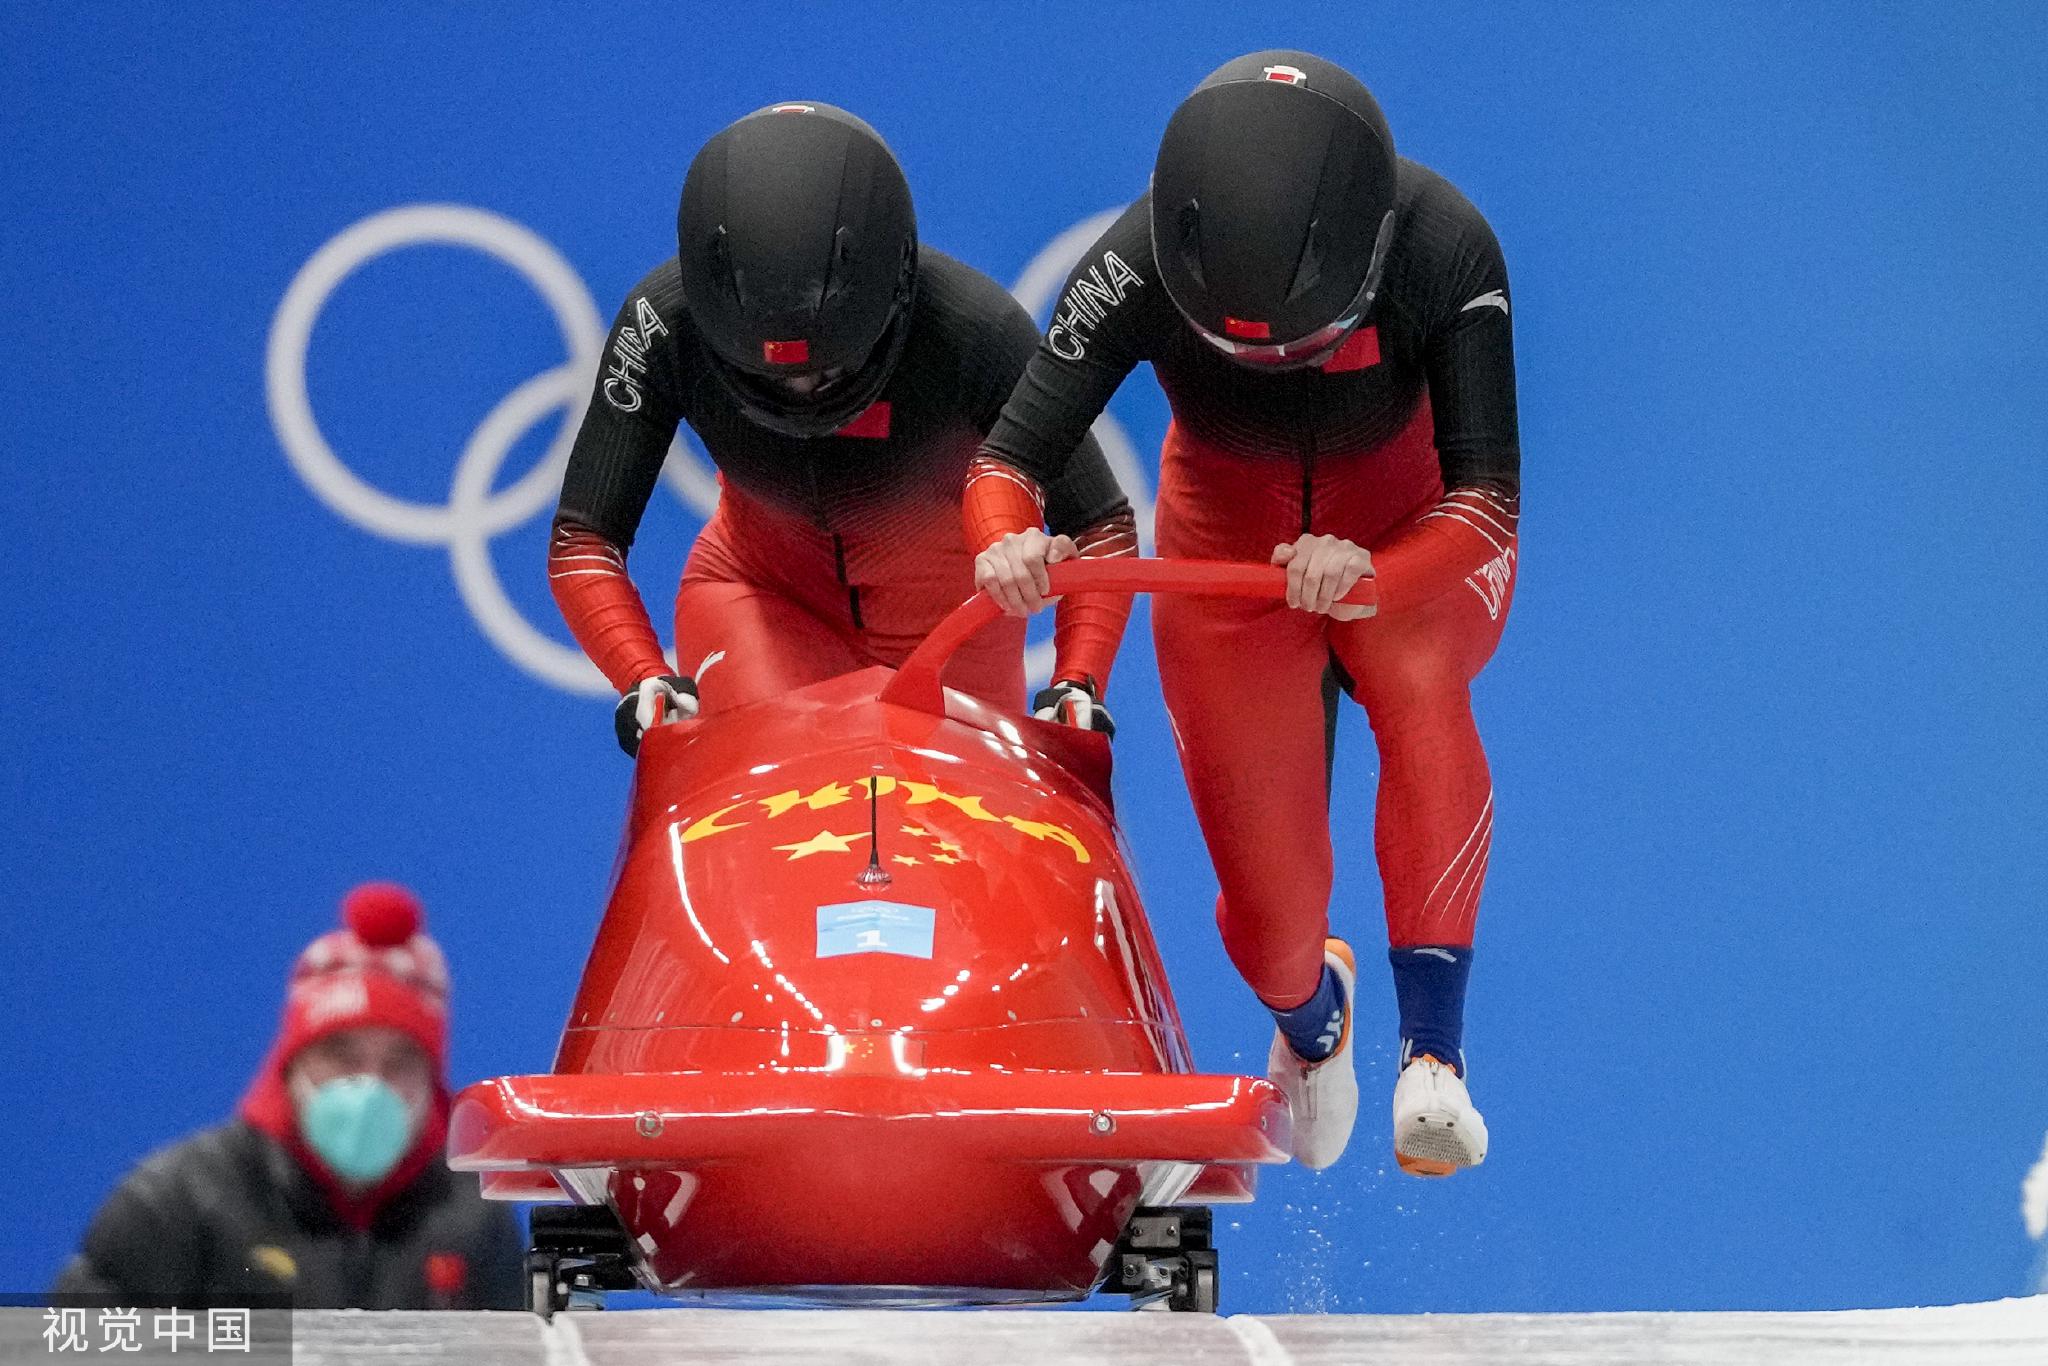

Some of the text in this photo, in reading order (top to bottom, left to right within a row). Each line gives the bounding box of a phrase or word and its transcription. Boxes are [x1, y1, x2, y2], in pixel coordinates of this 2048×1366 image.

[603, 296, 670, 413] CHINA
[1049, 250, 1145, 360] CHINA
[855, 929, 889, 949] 1
